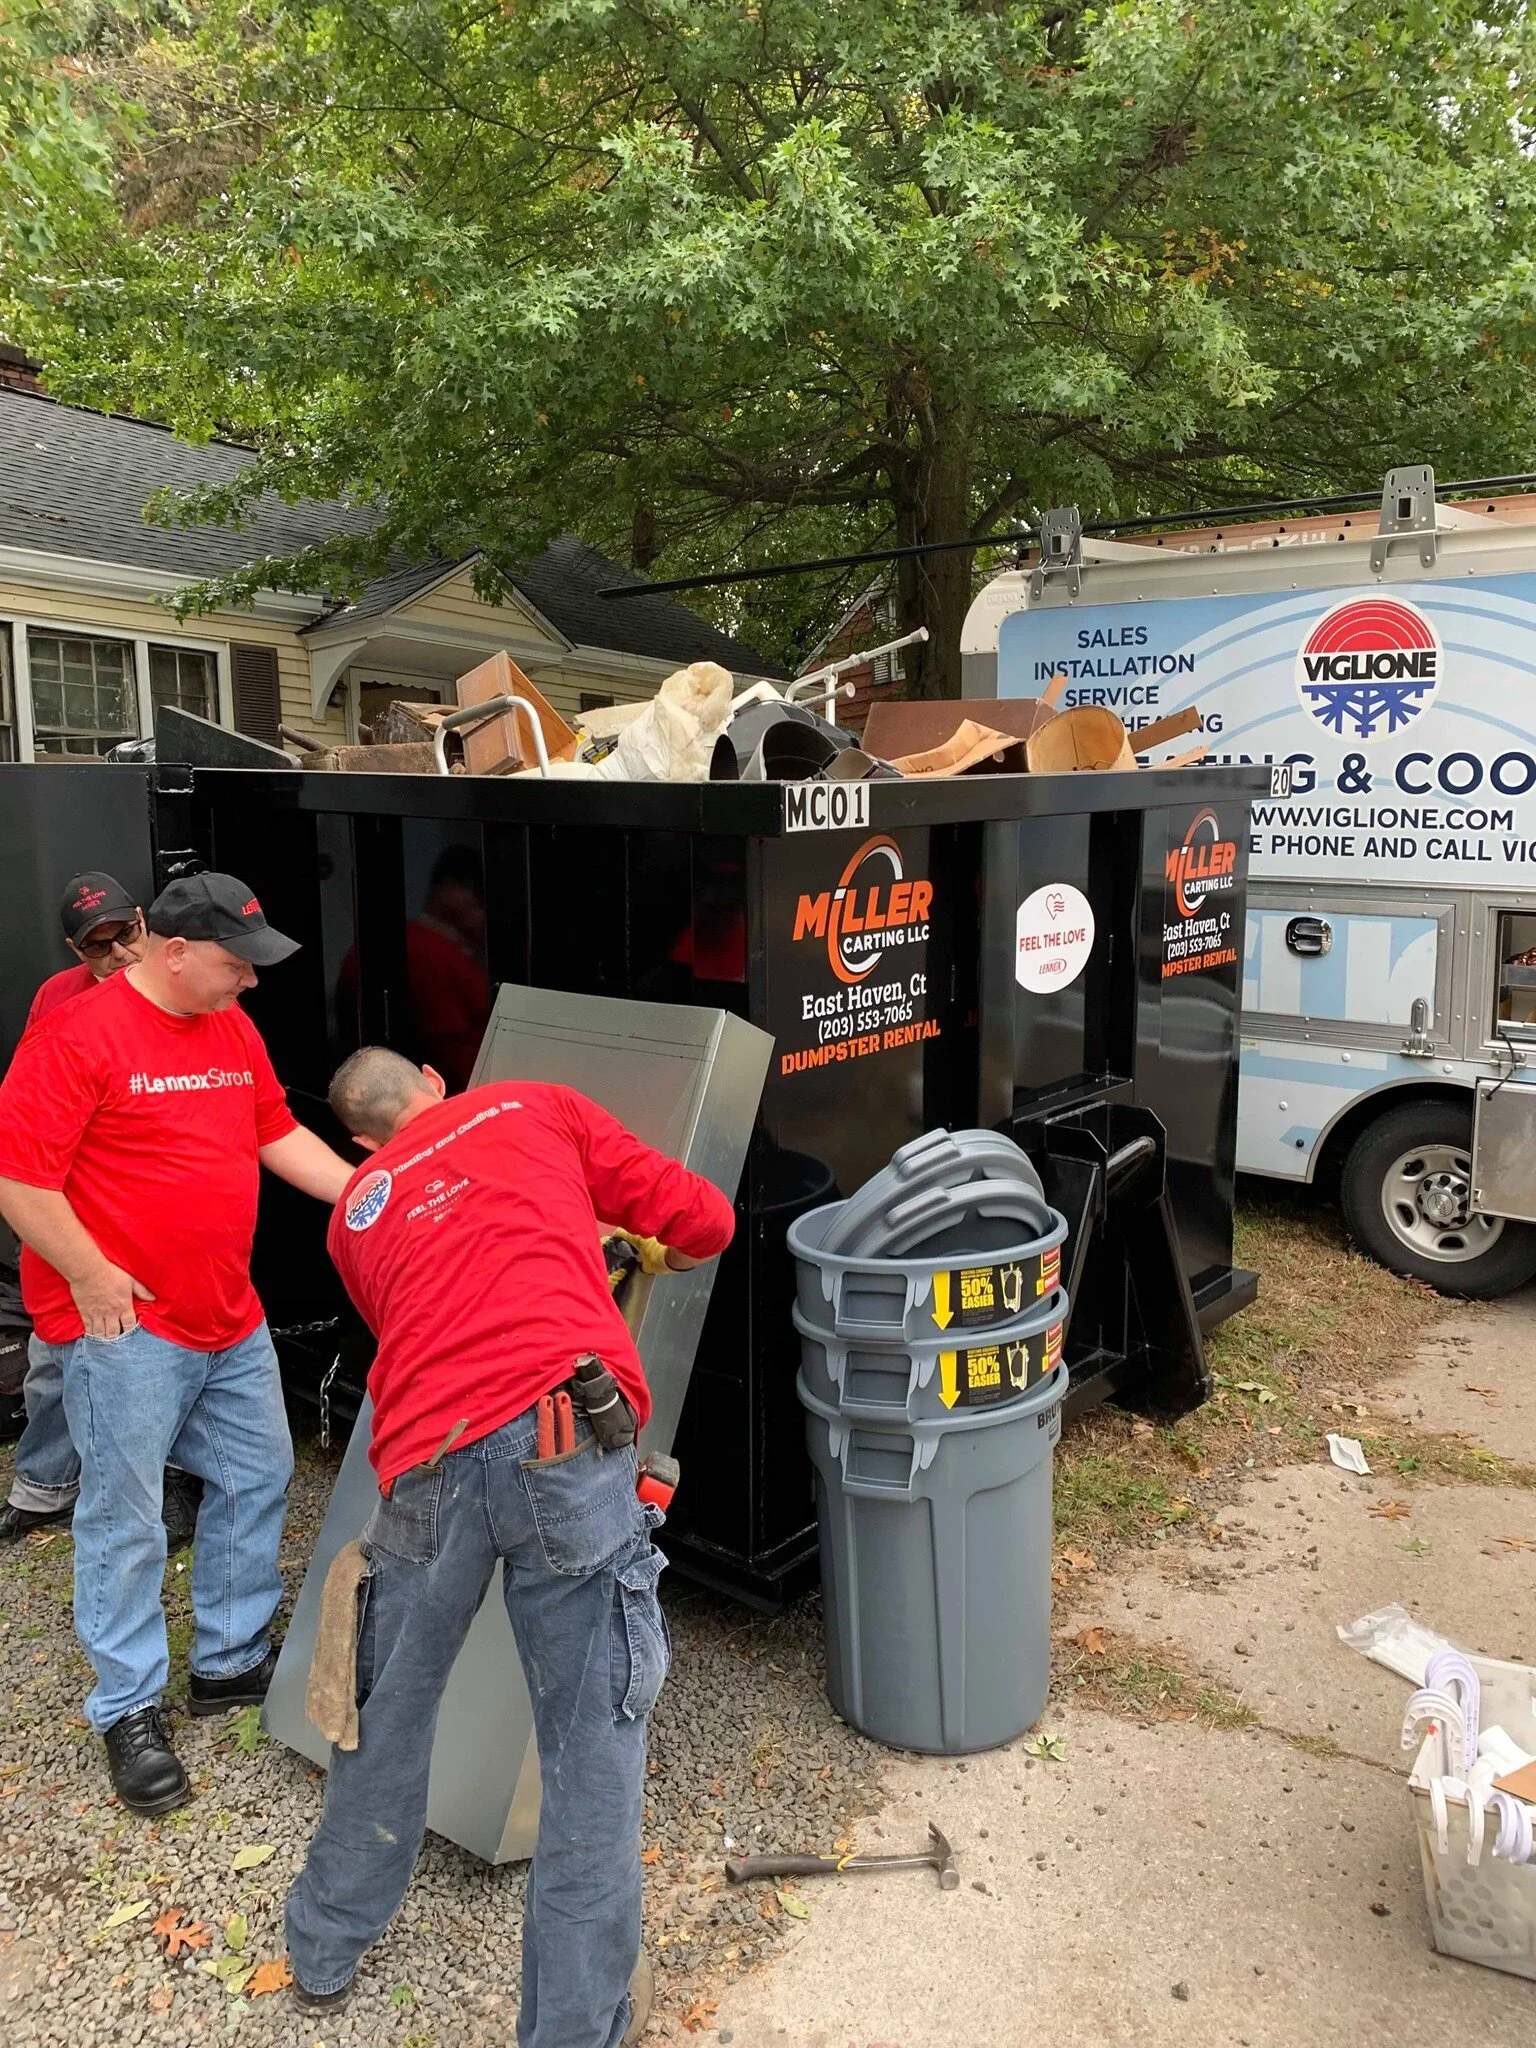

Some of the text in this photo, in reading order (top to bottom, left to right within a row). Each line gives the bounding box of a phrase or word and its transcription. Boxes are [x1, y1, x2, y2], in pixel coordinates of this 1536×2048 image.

[1077, 626, 1148, 649] SALES
[1034, 654, 1195, 680] INSTALLATION
[1303, 651, 1437, 681] VIGLIONE
[1065, 686, 1159, 708] SERVICE
[1272, 768, 1289, 795] 20
[1337, 752, 1373, 795] &
[1395, 751, 1536, 796] COO
[1271, 835, 1355, 856] PHONE
[1363, 837, 1417, 858] AND
[1426, 838, 1492, 861] CALL
[1184, 876, 1234, 895] CARTING LLC
[1185, 917, 1218, 938] Haven,
[1220, 912, 1231, 930] Ct
[843, 924, 930, 954] CARTING LLC
[1019, 928, 1086, 953] FEEL THE LOVE
[1168, 933, 1222, 961] (203) 553-7065
[1203, 947, 1238, 968] RENTAL
[802, 973, 927, 1021] East Haven, Ct
[818, 1001, 913, 1044] (203) 553-7065
[781, 1018, 941, 1075] DUMPSTER RENTAL
[129, 1067, 255, 1095] #LennoxStron
[407, 1177, 469, 1221] FEEL THE LOVE
[961, 1276, 993, 1298] 50%
[961, 1294, 995, 1310] EASIER
[967, 1354, 1000, 1377] 50%
[968, 1372, 1001, 1389] EASIER
